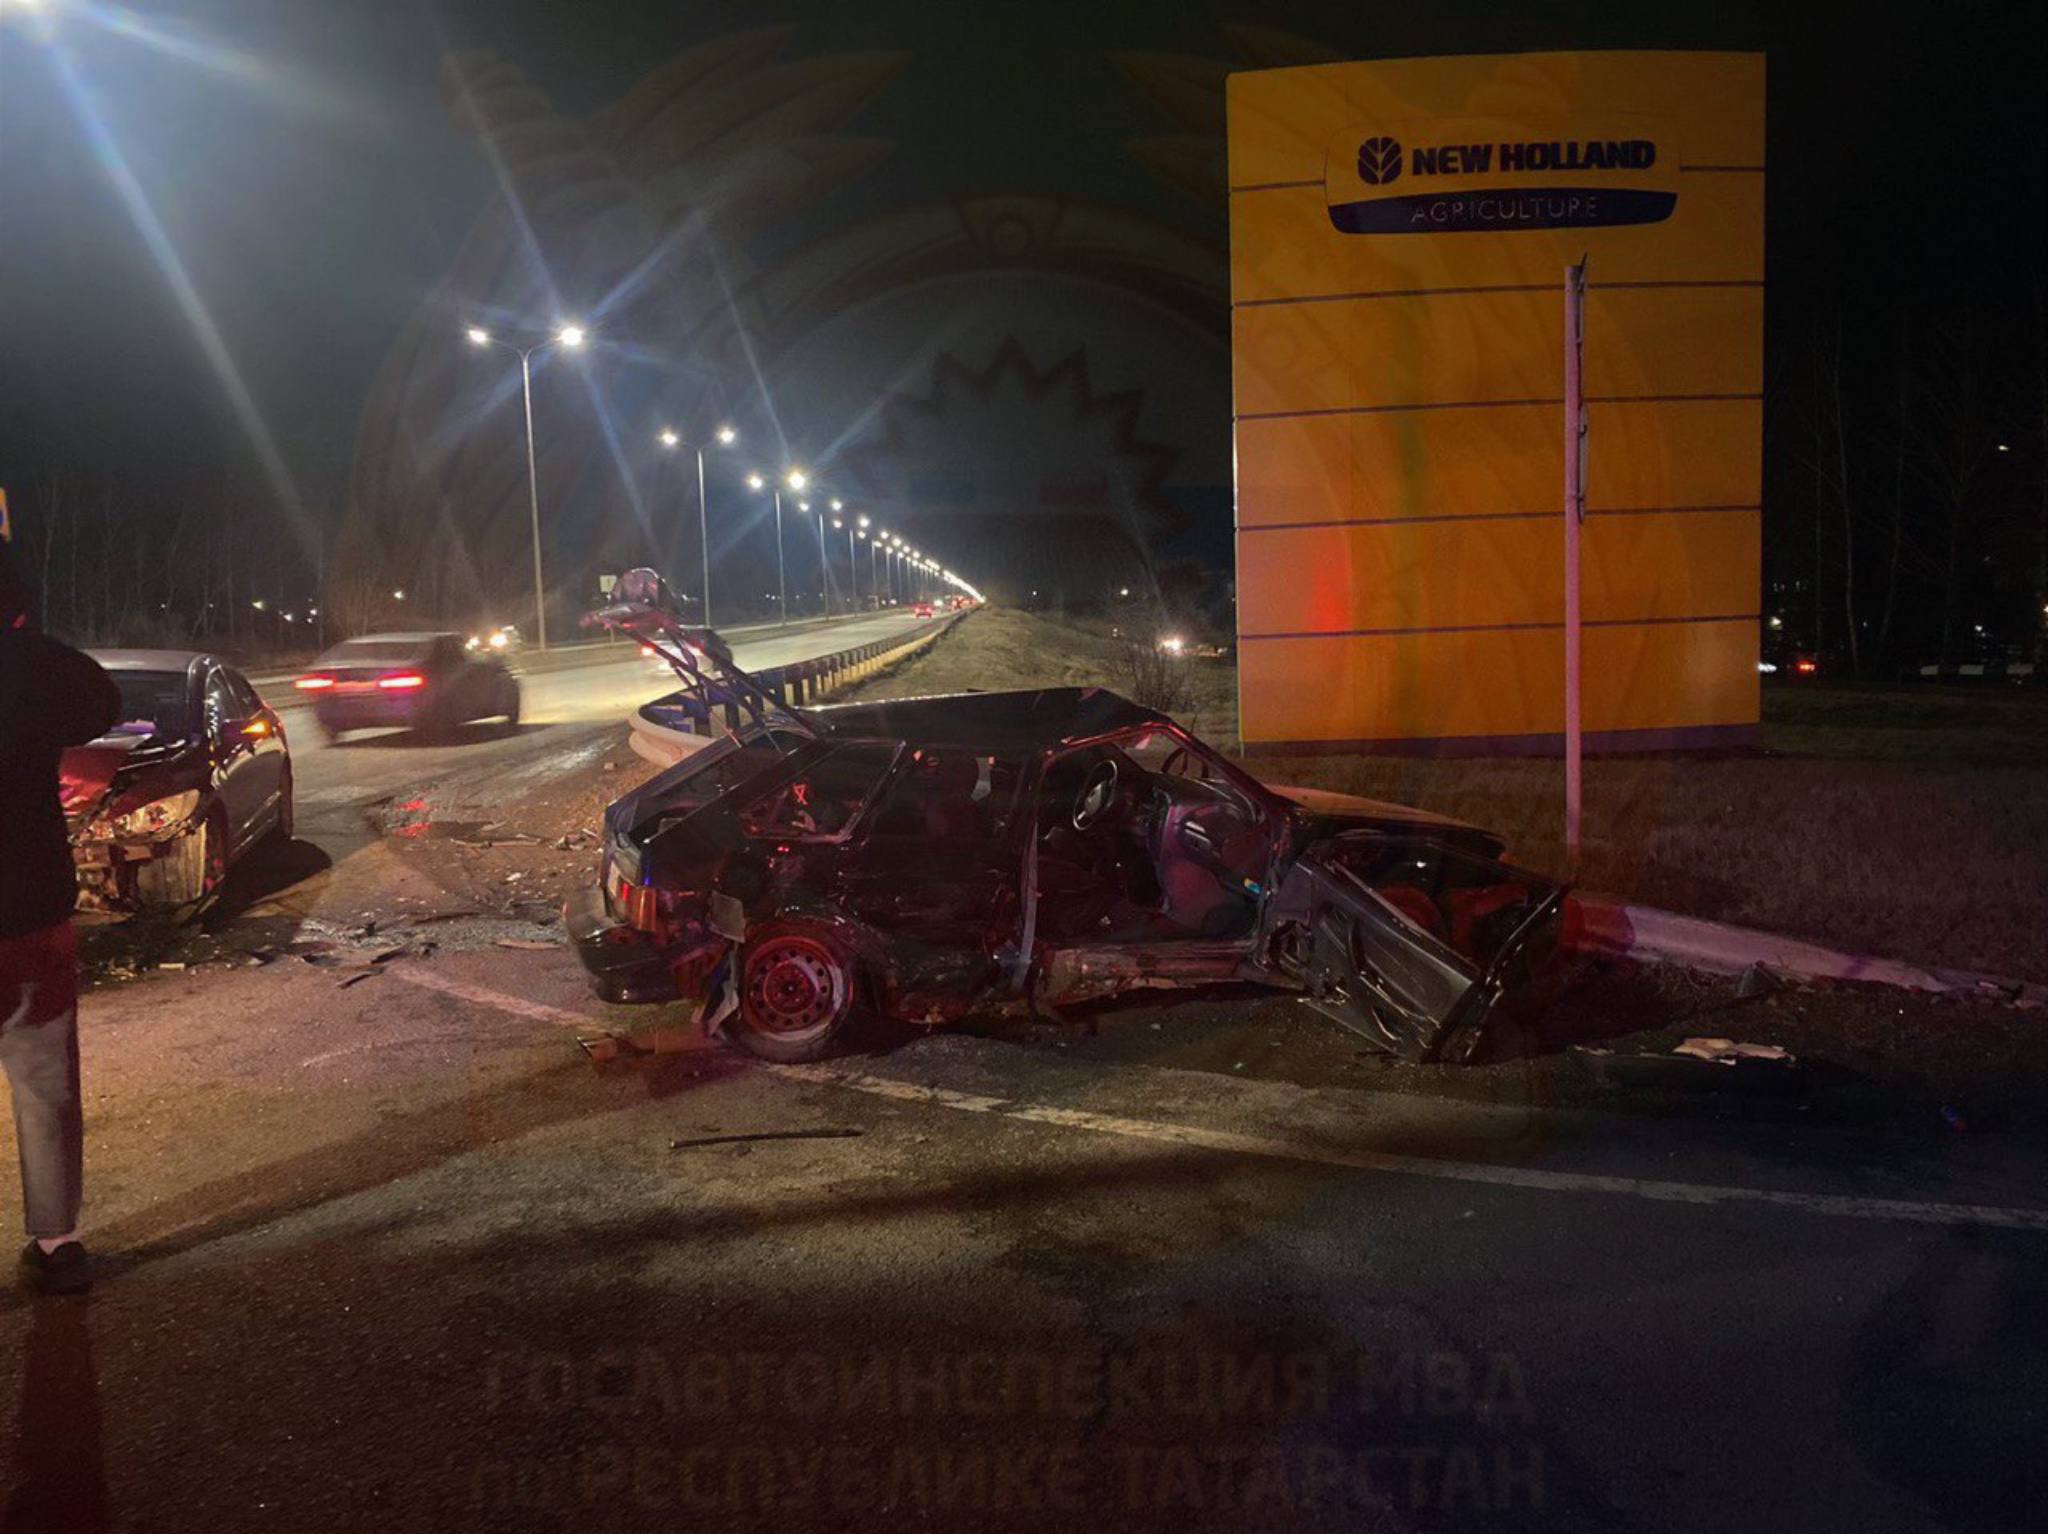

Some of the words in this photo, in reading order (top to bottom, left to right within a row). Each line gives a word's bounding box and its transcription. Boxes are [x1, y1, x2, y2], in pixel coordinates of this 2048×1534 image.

[1412, 144, 1492, 176] NEW
[1500, 140, 1656, 172] HOLLAND
[1410, 196, 1599, 224] AGRICULTURE
